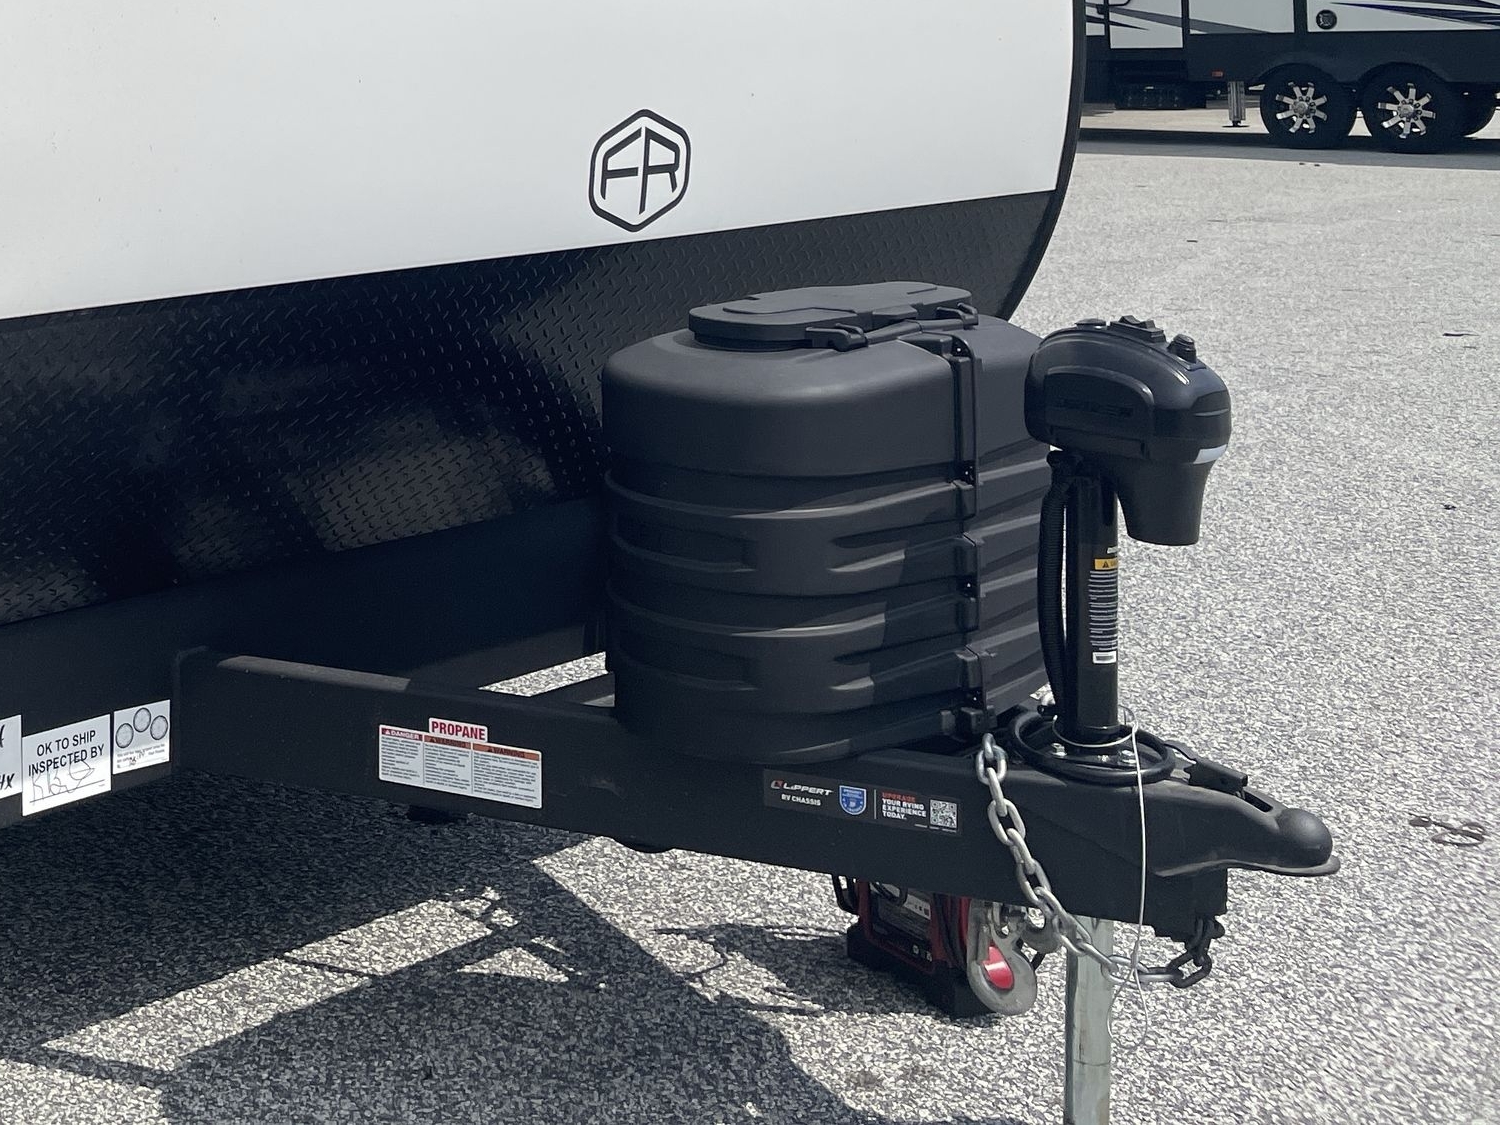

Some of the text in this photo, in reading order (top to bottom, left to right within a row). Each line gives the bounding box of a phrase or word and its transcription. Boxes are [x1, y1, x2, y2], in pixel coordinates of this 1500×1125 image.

[391, 730, 420, 741] DANGER
[431, 721, 486, 741] PROPANE
[37, 729, 96, 757] OK TO SHIP
[28, 749, 87, 777] INSPECTED
[90, 743, 105, 760] BY
[783, 782, 834, 796] LIPPERT
[791, 795, 822, 807] CHASSIS
[882, 798, 901, 806] YOUR
[882, 804, 927, 818] EXPERIENCE
[882, 810, 907, 820] TODAY.
